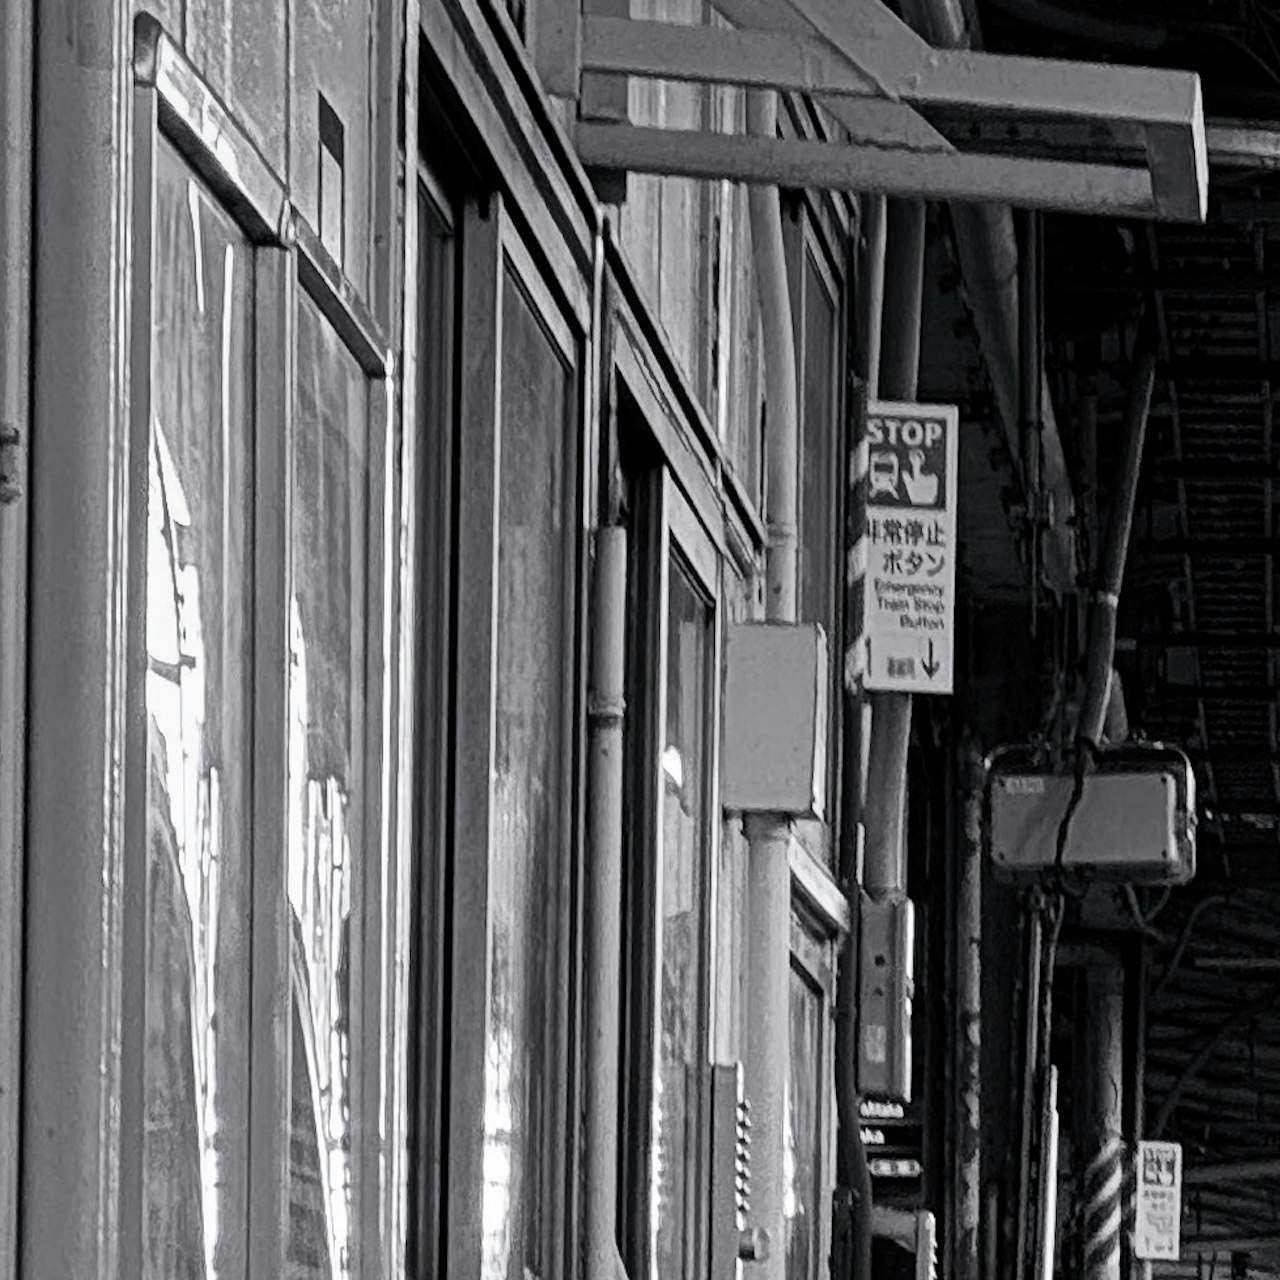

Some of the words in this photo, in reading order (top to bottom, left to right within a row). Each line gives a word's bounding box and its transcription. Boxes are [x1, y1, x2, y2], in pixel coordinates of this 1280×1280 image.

[867, 418, 943, 447] STOP
[882, 549, 946, 577] ボタン
